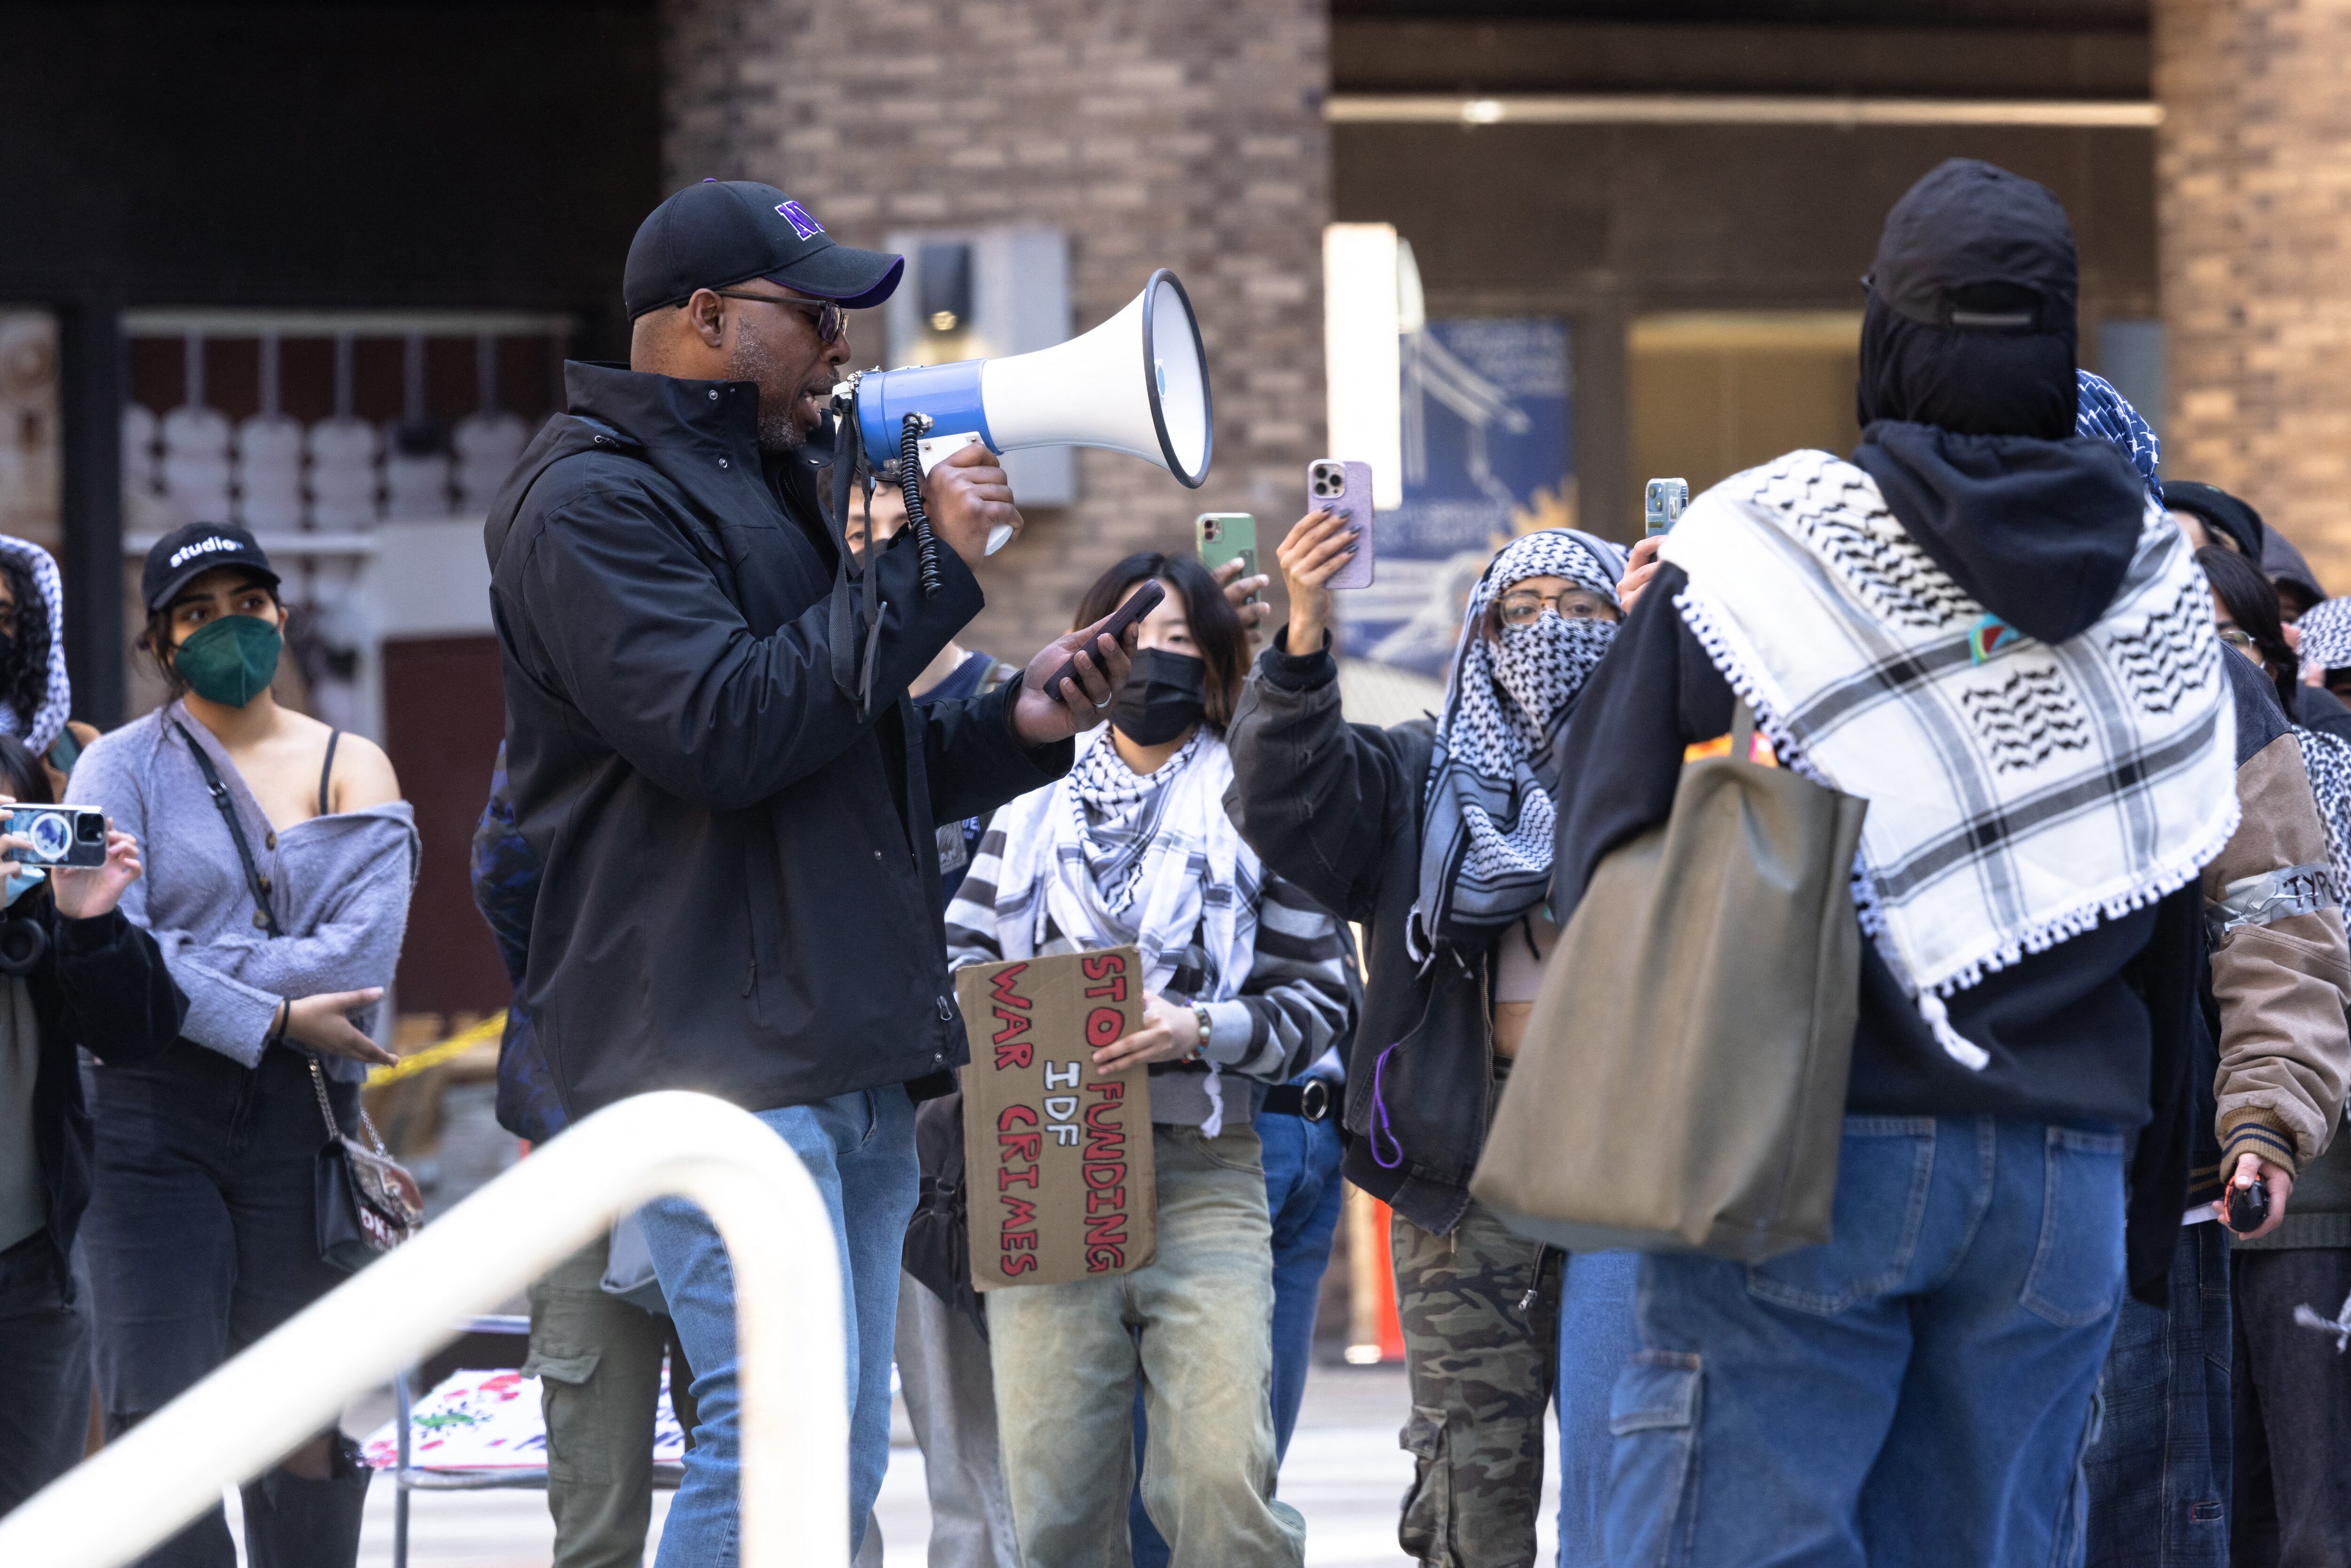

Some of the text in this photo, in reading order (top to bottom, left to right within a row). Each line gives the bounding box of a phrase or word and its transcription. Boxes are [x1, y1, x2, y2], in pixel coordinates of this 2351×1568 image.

[170, 536, 236, 567] studio
[989, 962, 1042, 1276] WAR CRIMES
[1043, 1059, 1081, 1147] IDF
[1081, 954, 1128, 1273] STO FUNDING
